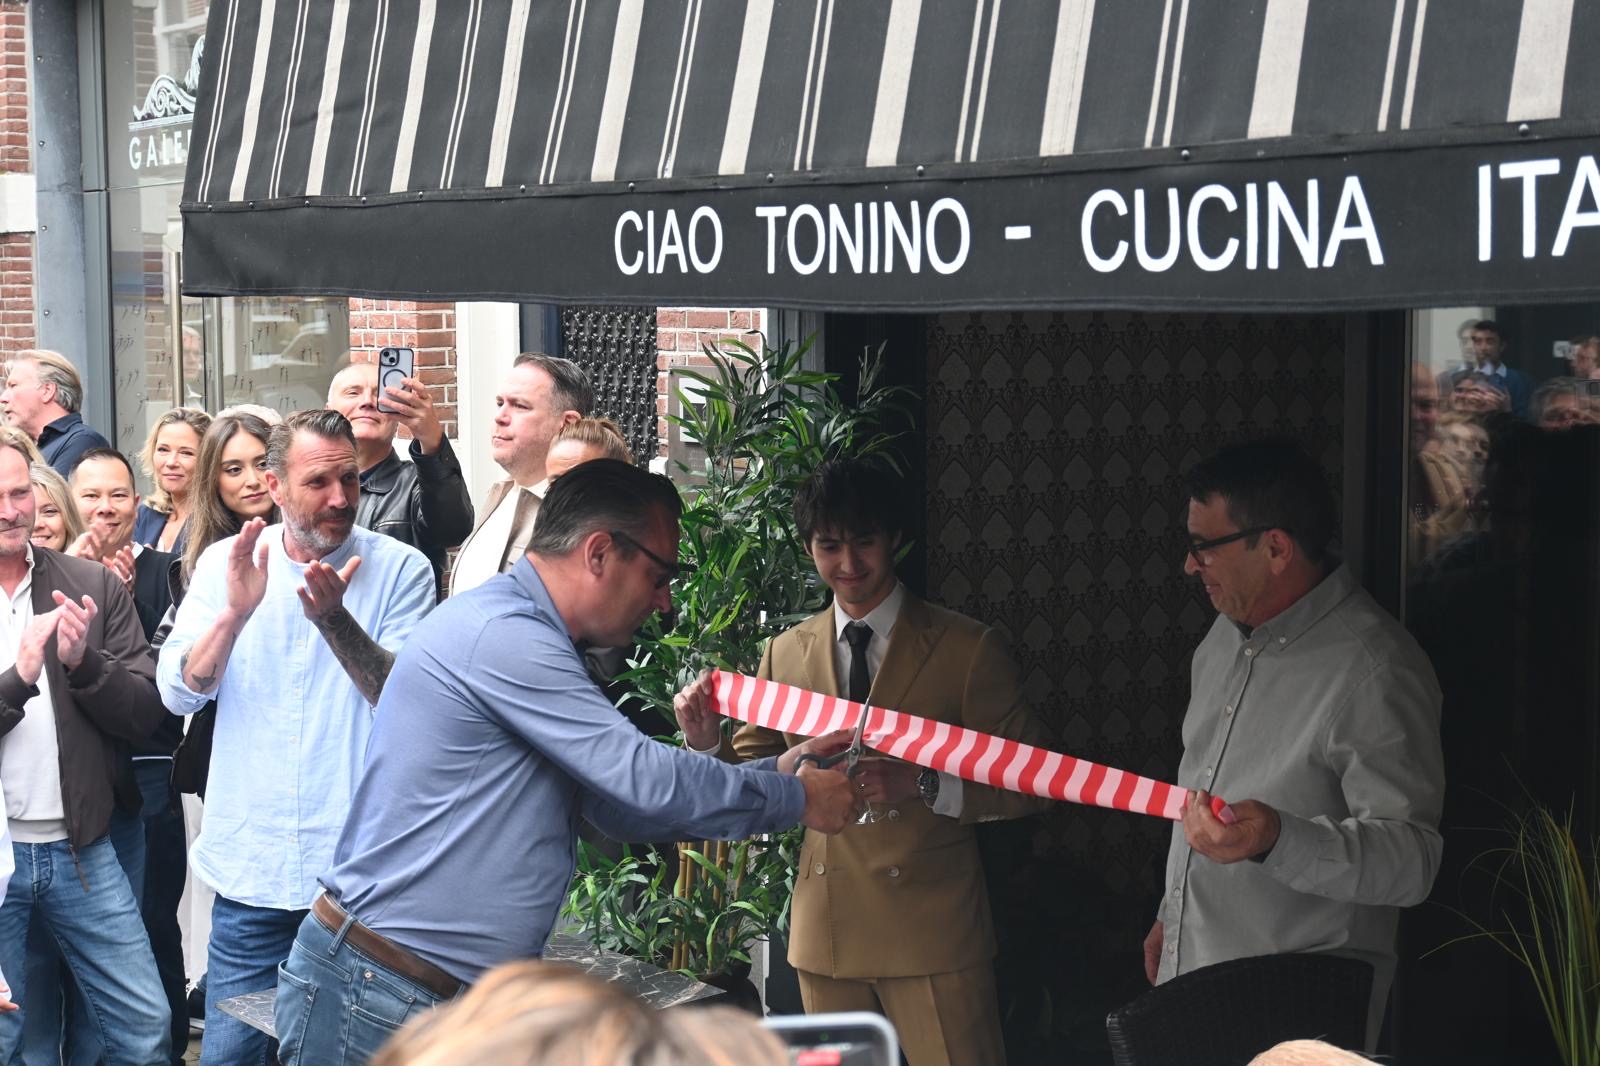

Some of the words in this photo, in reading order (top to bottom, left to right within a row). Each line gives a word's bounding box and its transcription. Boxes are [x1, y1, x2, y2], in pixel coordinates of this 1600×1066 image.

[129, 130, 191, 169] GALE
[614, 205, 723, 276] CIAO
[755, 197, 971, 275] TONINO
[1004, 225, 1032, 240] -
[1080, 175, 1385, 273] CUCINA
